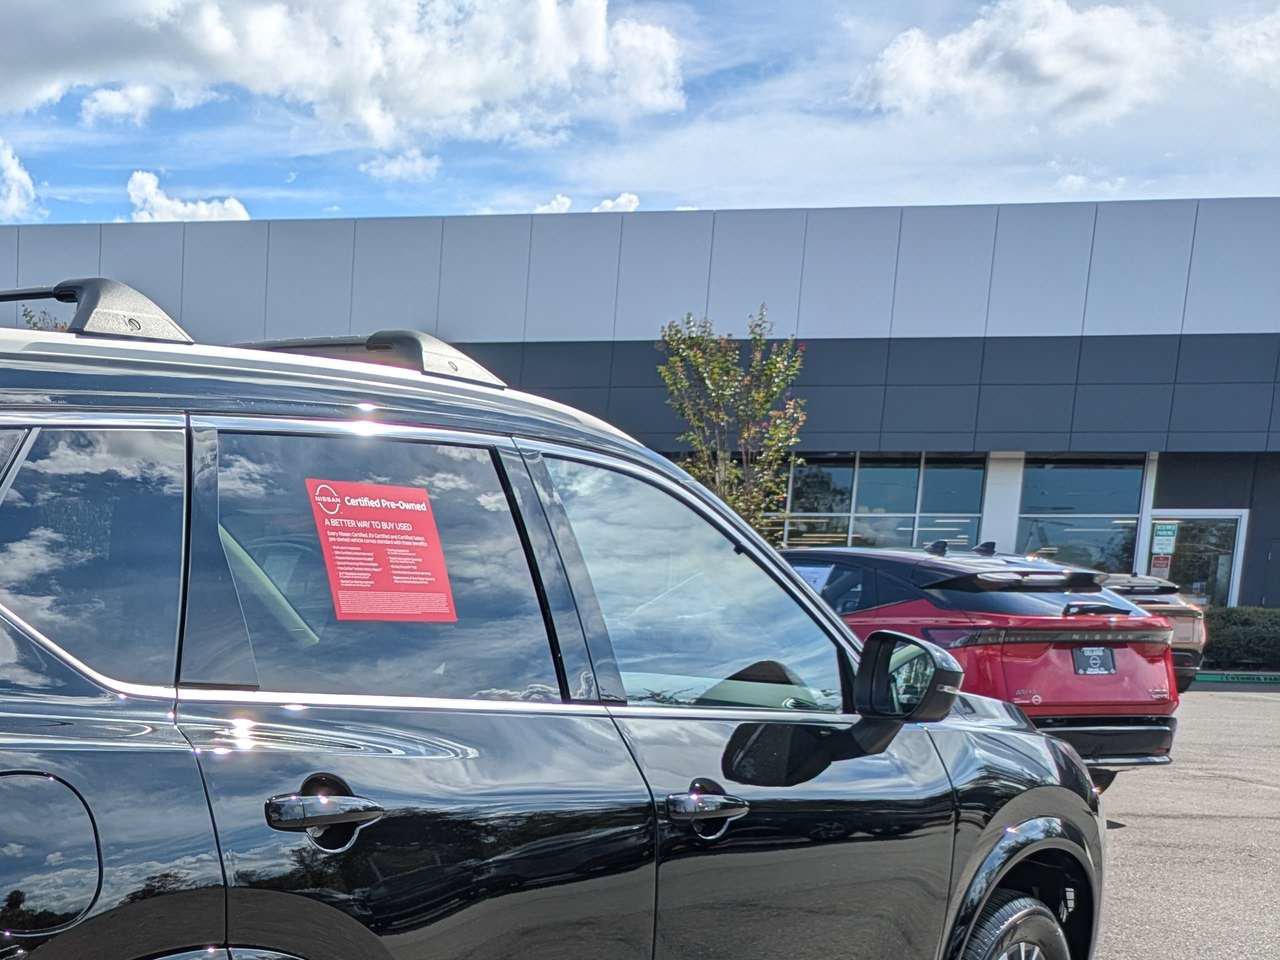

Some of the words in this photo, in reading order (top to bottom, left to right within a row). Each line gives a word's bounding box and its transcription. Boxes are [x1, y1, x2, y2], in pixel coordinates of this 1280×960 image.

[344, 496, 380, 508] Certified
[381, 499, 427, 511] Pre-Owned
[330, 518, 356, 528] BETTER
[356, 520, 371, 528] WAY
[371, 520, 380, 529] TO
[381, 521, 395, 530] BUY
[395, 522, 412, 531] USED
